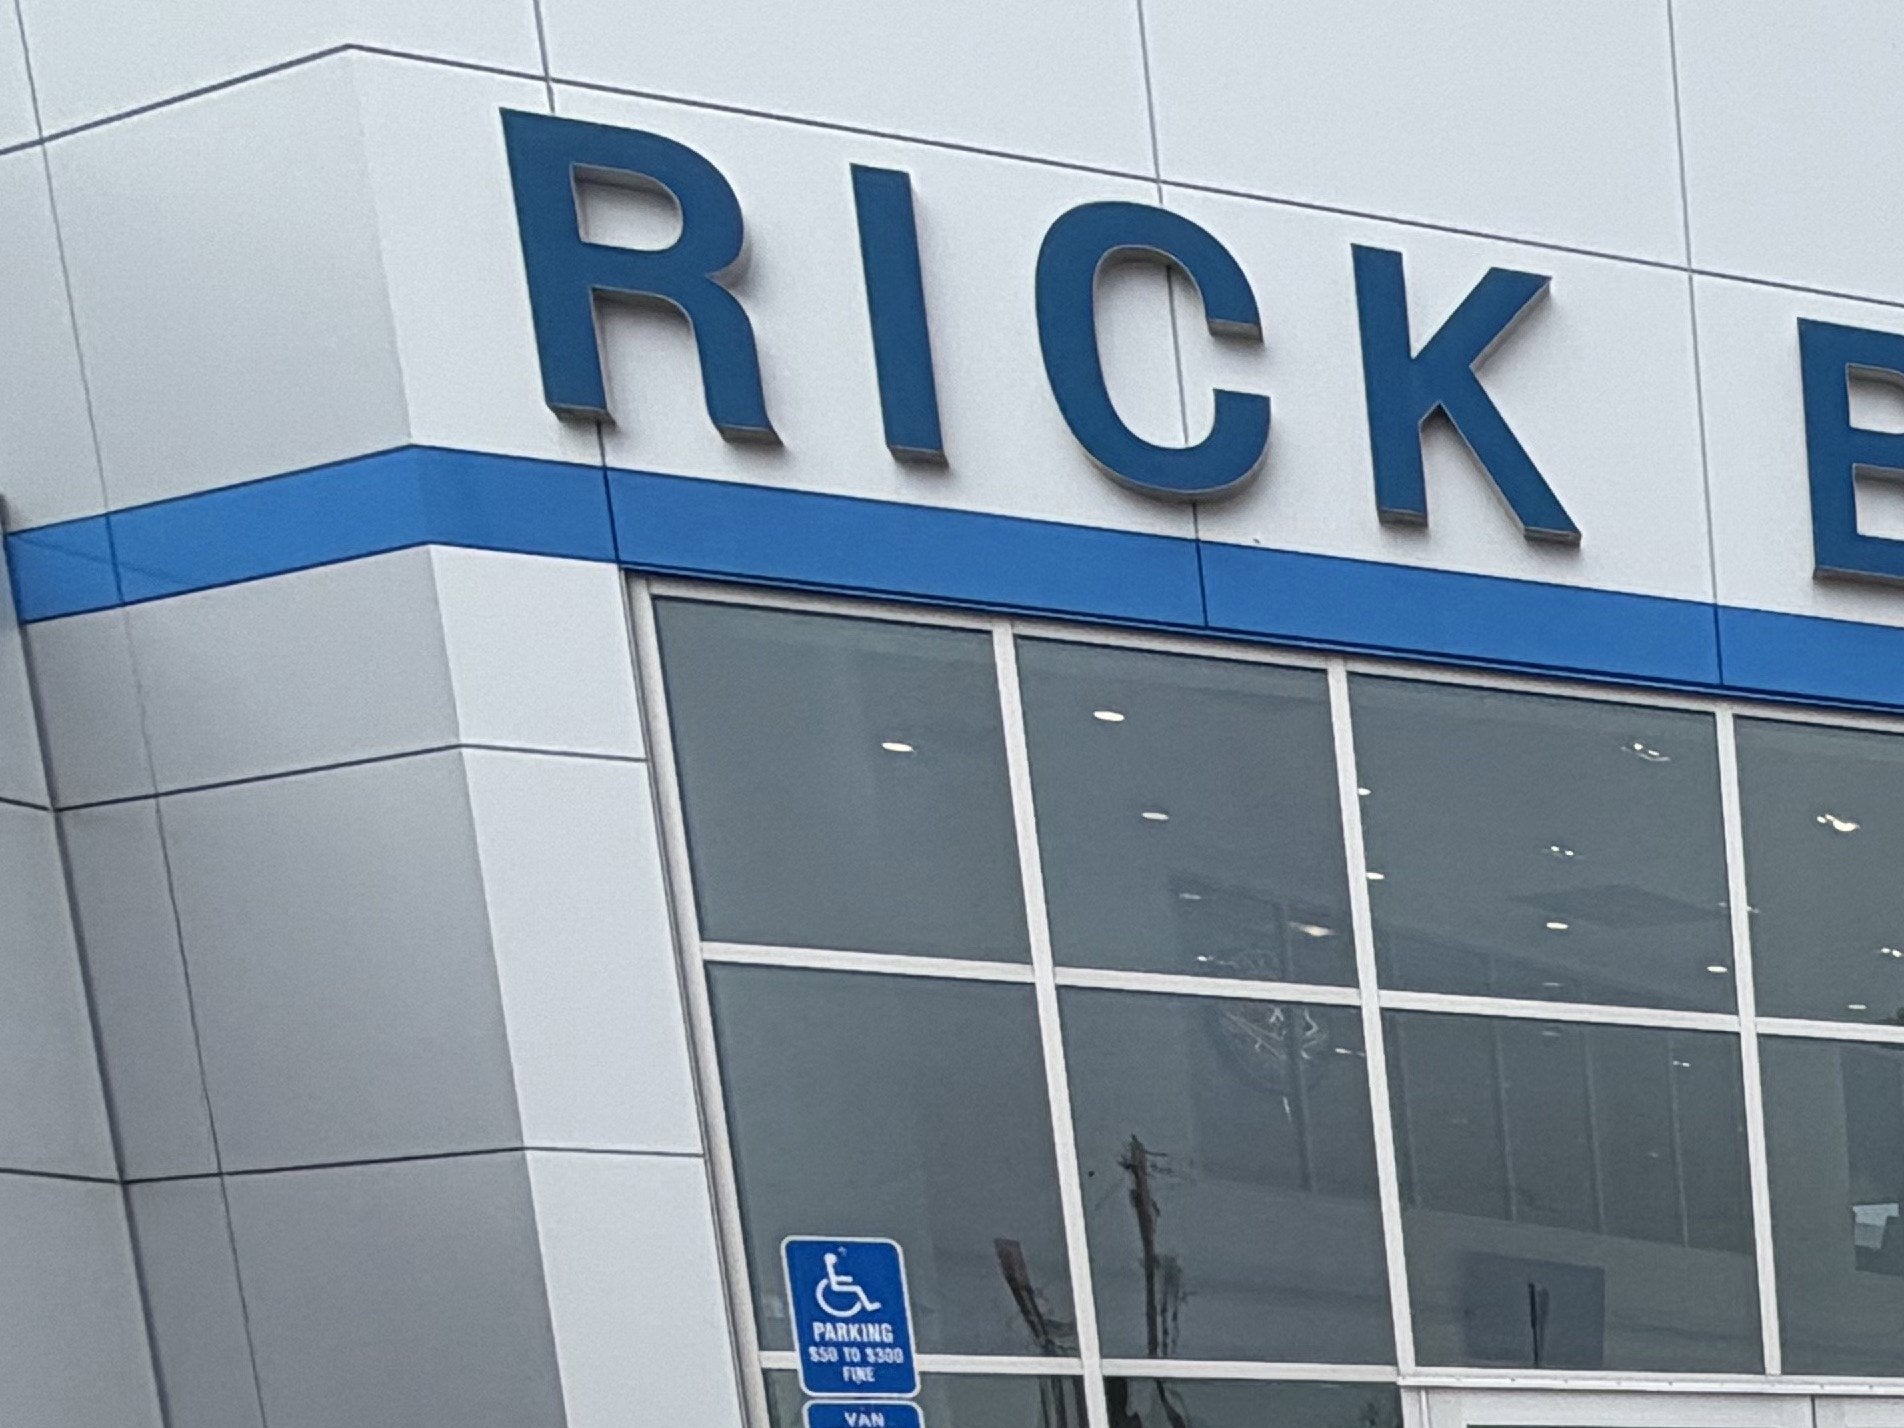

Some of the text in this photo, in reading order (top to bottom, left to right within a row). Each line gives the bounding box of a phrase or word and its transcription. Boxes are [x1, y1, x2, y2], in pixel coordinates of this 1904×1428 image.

[499, 107, 1583, 549] RICK
[812, 1321, 894, 1344] PARKING
[808, 1346, 904, 1364] $50 TO $300
[842, 1366, 876, 1383] FINE
[844, 1411, 885, 1428] VAN
